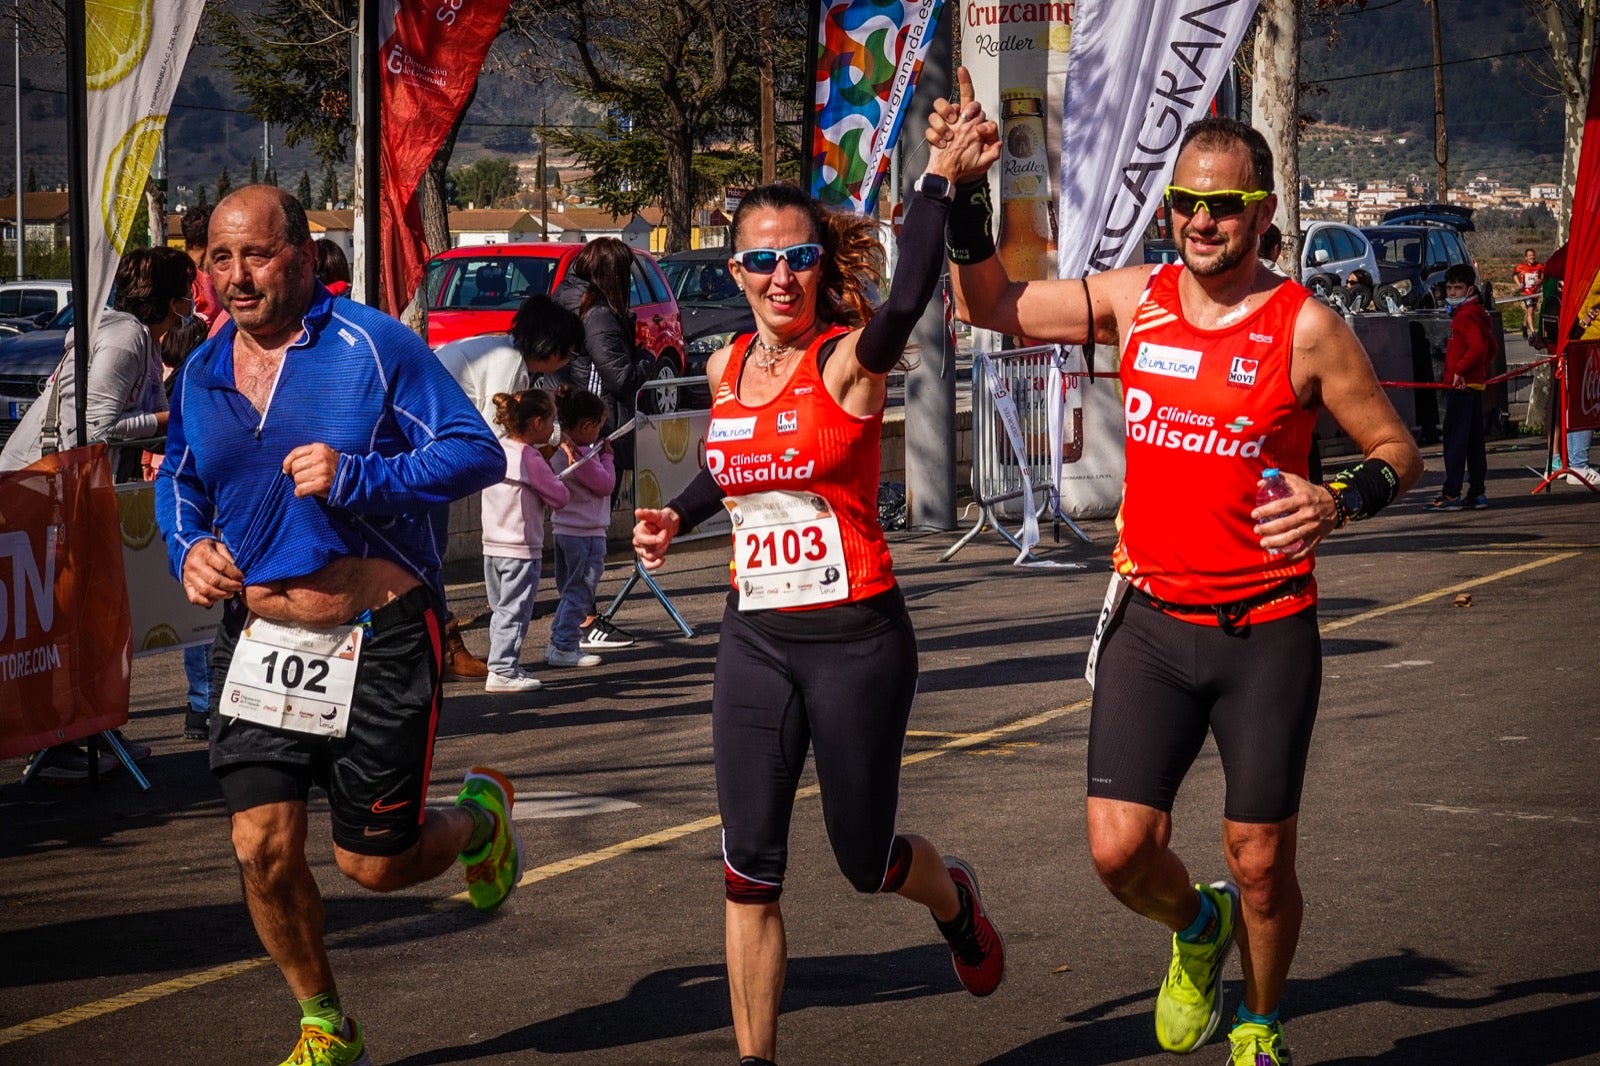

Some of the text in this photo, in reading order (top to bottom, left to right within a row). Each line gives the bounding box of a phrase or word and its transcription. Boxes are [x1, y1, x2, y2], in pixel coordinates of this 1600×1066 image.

[976, 33, 1035, 57] Radler
[403, 55, 447, 76] Diputación
[411, 69, 447, 87] Granada
[864, 0, 932, 188] www.turgranada.es
[1004, 159, 1046, 176] Radler
[1233, 359, 1240, 372] I
[1228, 372, 1255, 384] MOVE
[1125, 387, 1267, 459] Polisalud
[1156, 406, 1216, 428] Clínicas
[706, 449, 815, 487] Polisalud
[730, 453, 773, 467] Clínicas
[746, 525, 828, 570] 2103
[261, 650, 330, 694] 102
